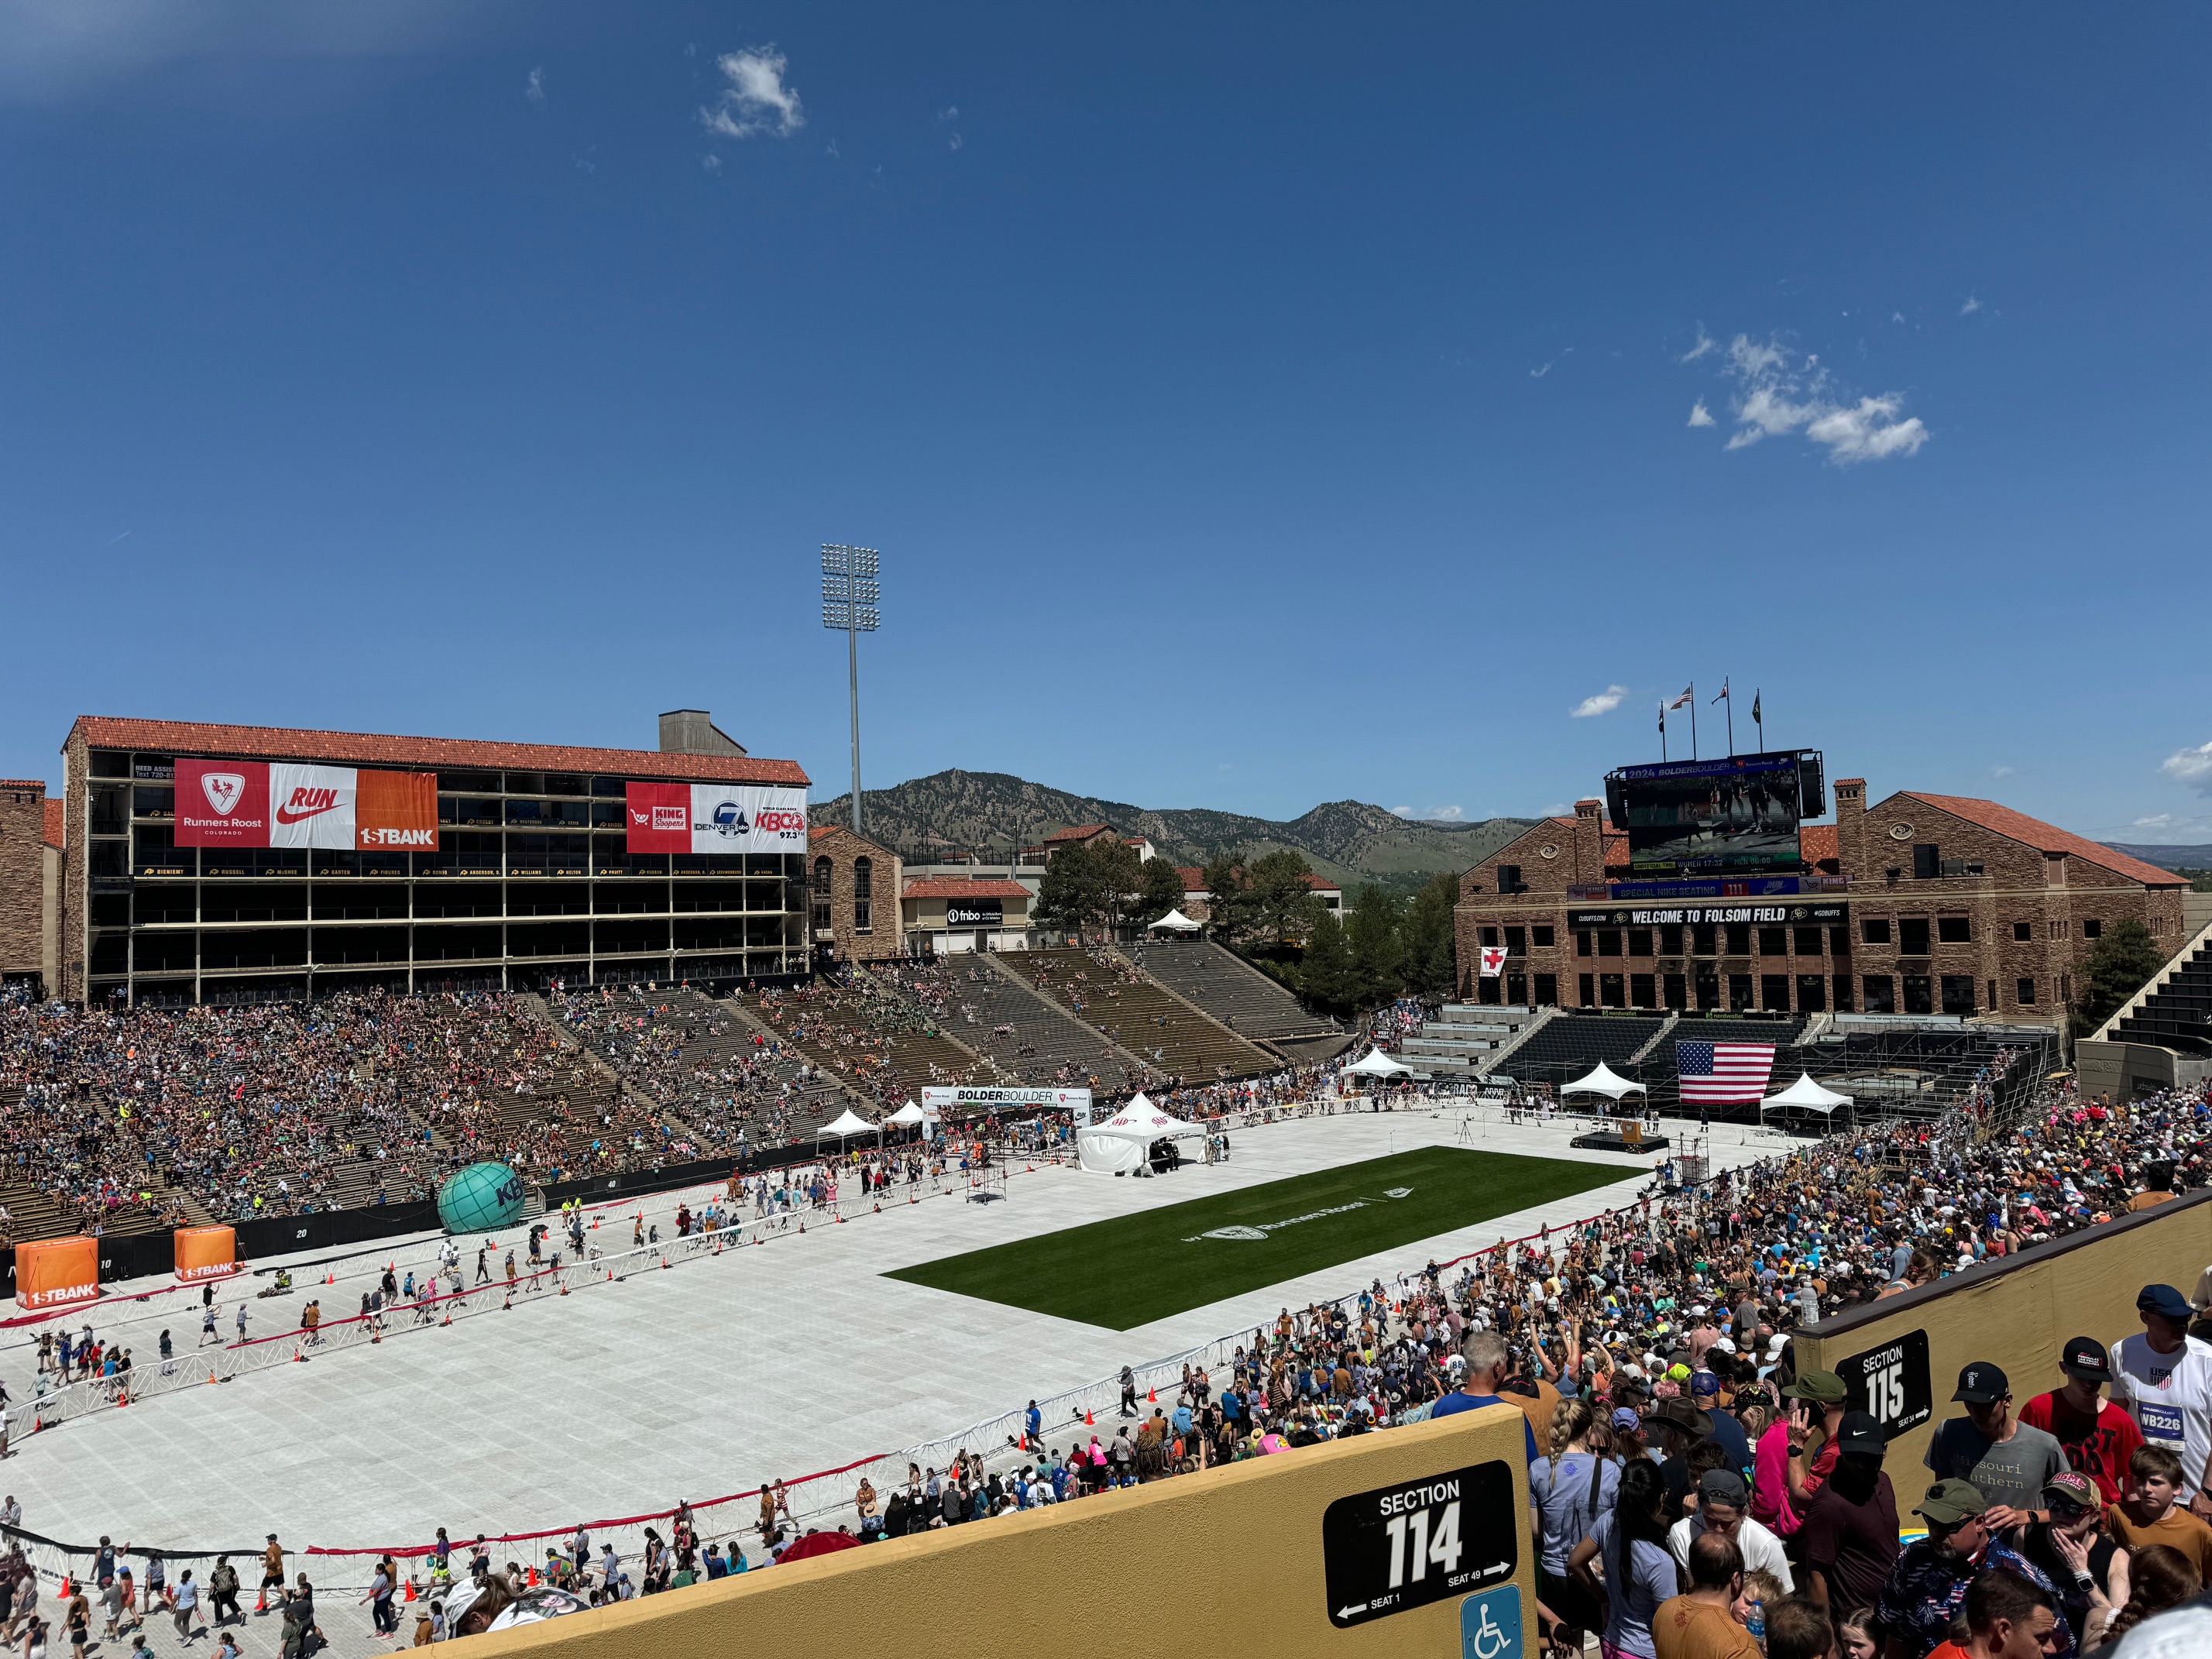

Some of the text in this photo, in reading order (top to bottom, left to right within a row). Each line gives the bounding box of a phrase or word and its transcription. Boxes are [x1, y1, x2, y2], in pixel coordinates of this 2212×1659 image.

[1629, 763, 1729, 778] 2024 BOLDERBOULDER
[289, 787, 338, 808] RUN
[655, 809, 683, 819] KING
[754, 810, 805, 833] KBCO
[184, 817, 262, 828] Runners Roost
[654, 819, 684, 829] Soopers
[360, 828, 434, 845] 1STBANK
[1679, 887, 1716, 895] SEATING
[1727, 884, 1743, 895] 111
[960, 910, 981, 921] fnbo
[1632, 908, 1786, 924] WELCOME TO FOLSOM FIELD
[957, 1090, 1053, 1101] BOLDERBOULDER
[608, 1180, 617, 1189] 40
[1255, 1201, 1370, 1230] Runners Roost
[296, 1229, 307, 1238] 20
[101, 1259, 112, 1269] 10
[186, 1262, 233, 1279] 1STBANK
[31, 1283, 96, 1304] 1STBANK
[1452, 1360, 1462, 1369] 88
[1863, 1345, 1903, 1373] SECTION
[2150, 1367, 2172, 1377] USA
[1866, 1361, 1904, 1425] 115
[1898, 1416, 1909, 1428] SEAT
[2140, 1413, 2181, 1431] WB226
[2066, 1446, 2104, 1477] DO
[1014, 1483, 1022, 1493] 90
[2054, 1472, 2087, 1489] USMC
[1380, 1479, 1460, 1516] SECTION
[1386, 1500, 1463, 1589] 114
[1448, 1570, 1481, 1587] SEAT 49
[1371, 1592, 1400, 1610] SEAT 1
